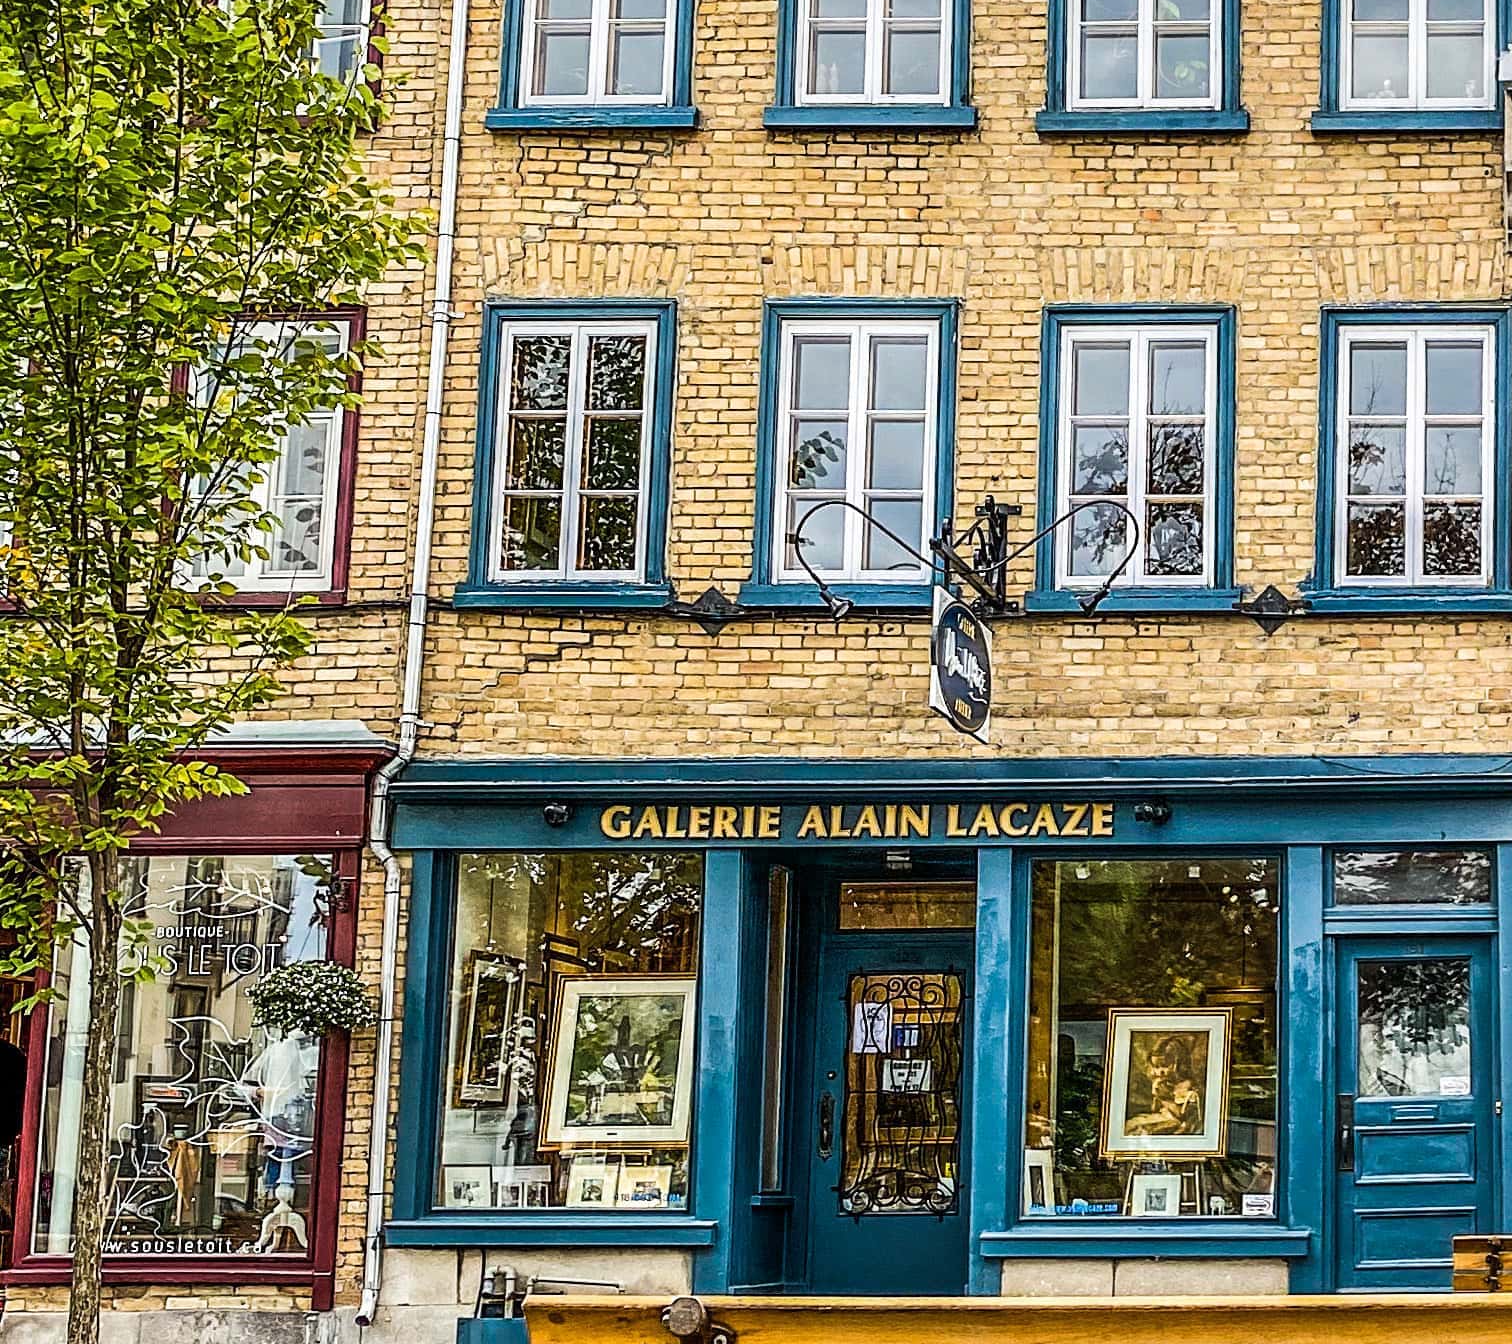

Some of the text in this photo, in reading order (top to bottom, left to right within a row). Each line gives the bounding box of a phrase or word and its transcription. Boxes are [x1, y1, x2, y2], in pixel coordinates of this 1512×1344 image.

[600, 802, 1114, 839] GALERIE ALAIN LACAZE
[188, 944, 212, 975] LE
[220, 943, 282, 976] TOIT
